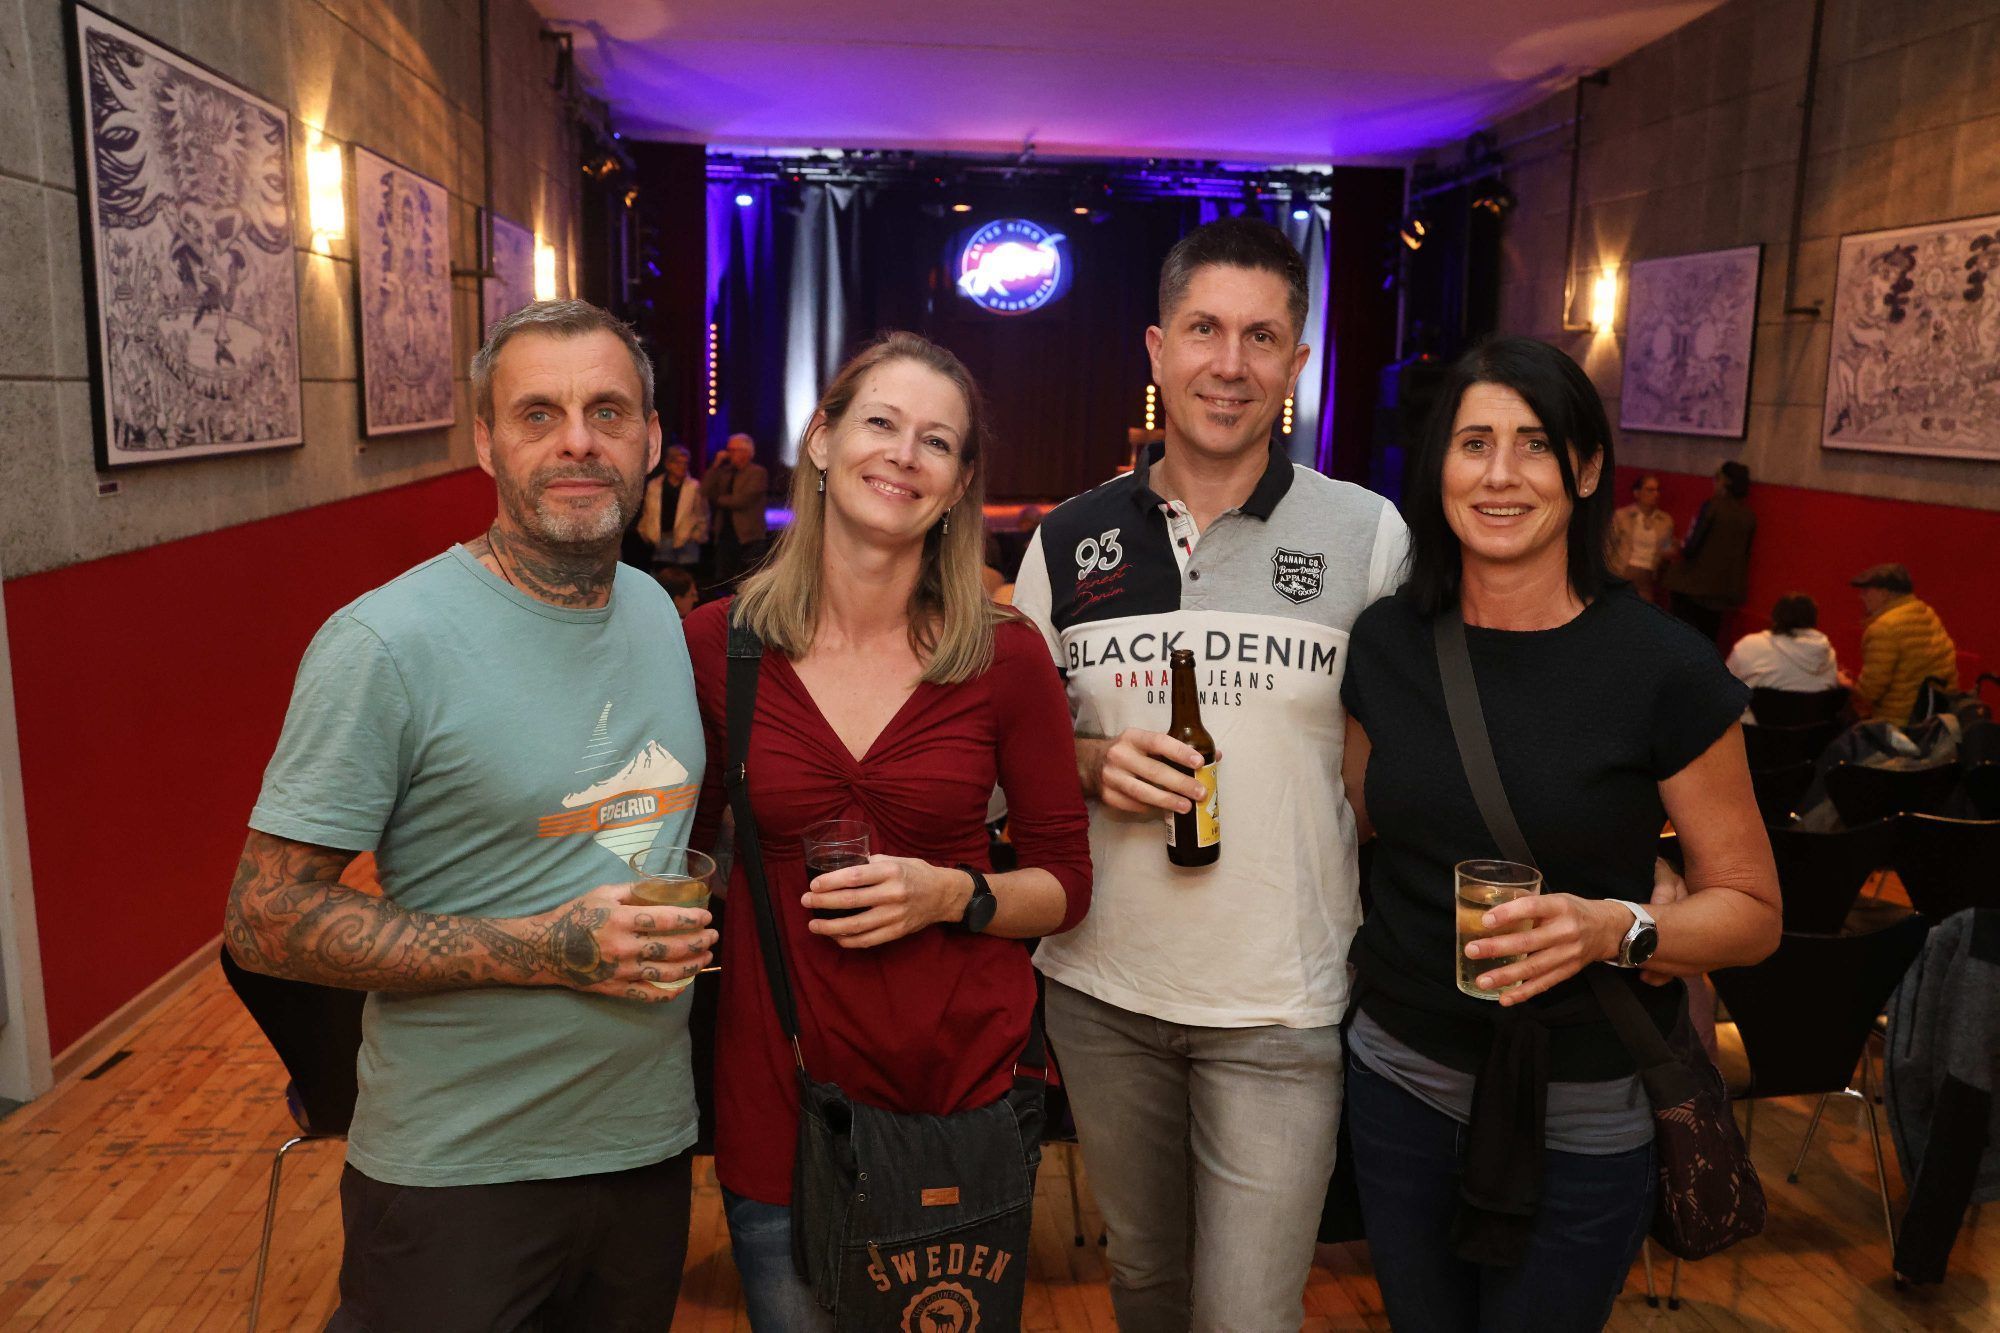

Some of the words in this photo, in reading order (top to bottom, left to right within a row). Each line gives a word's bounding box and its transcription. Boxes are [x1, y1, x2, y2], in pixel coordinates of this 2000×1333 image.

[1075, 527, 1123, 581] 93
[1279, 554, 1306, 564] BANANI
[1280, 574, 1318, 587] APPAREL
[1069, 630, 1186, 670] BLACK
[1205, 630, 1337, 676] DENIM
[1115, 669, 1169, 688] BANA
[1207, 669, 1275, 691] JEANS
[1147, 690, 1242, 706] ORNALS
[600, 797, 656, 823] EDELRID
[867, 1243, 1012, 1291] SWEDEN
